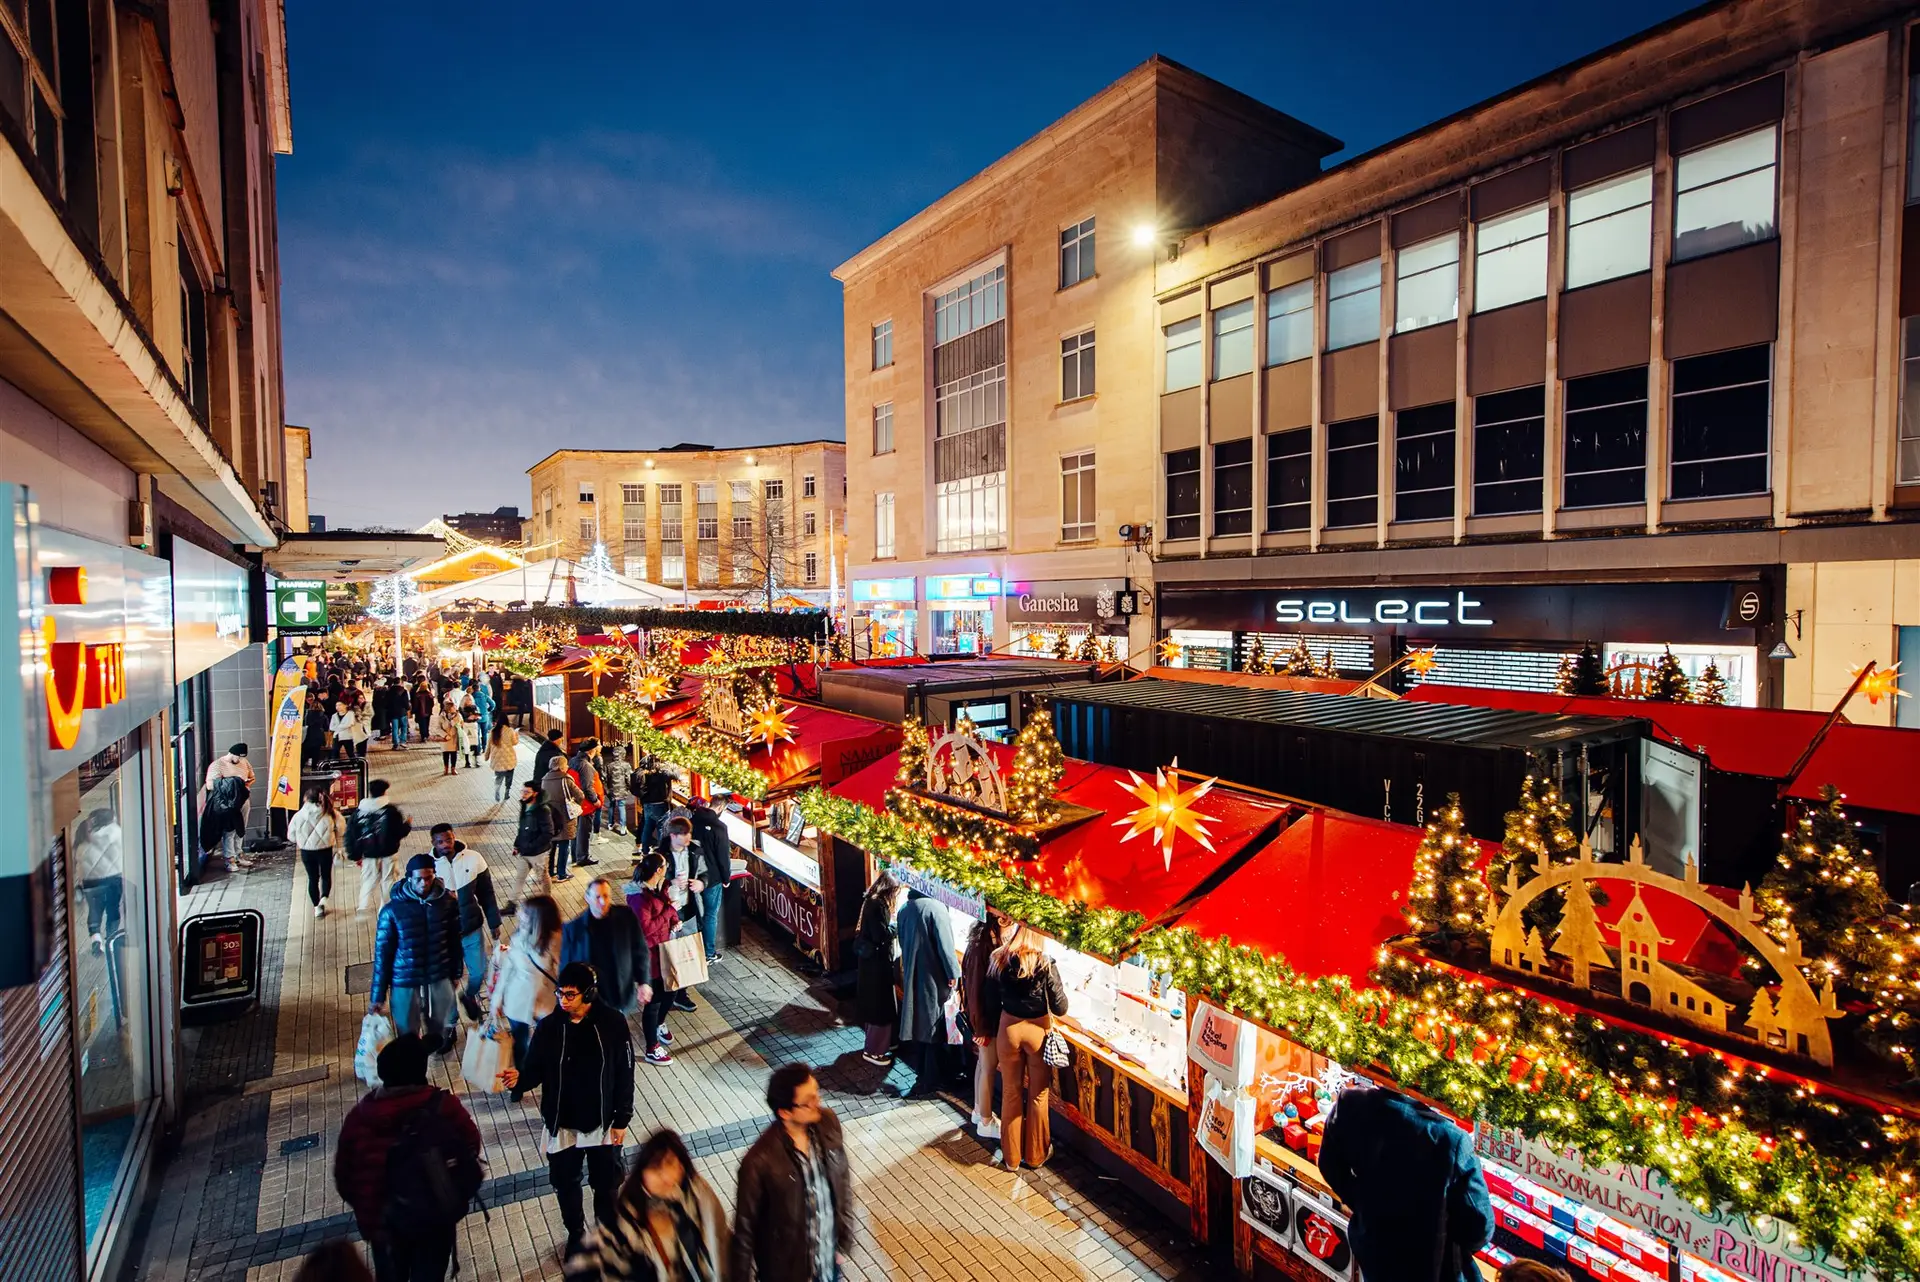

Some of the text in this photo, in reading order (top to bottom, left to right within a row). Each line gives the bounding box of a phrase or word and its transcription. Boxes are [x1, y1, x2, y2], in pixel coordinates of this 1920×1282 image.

[1019, 592, 1079, 613] Ganesha
[900, 868, 934, 897] BESPOKE
[752, 877, 814, 938] THRONES
[1476, 1133, 1522, 1168] FREE
